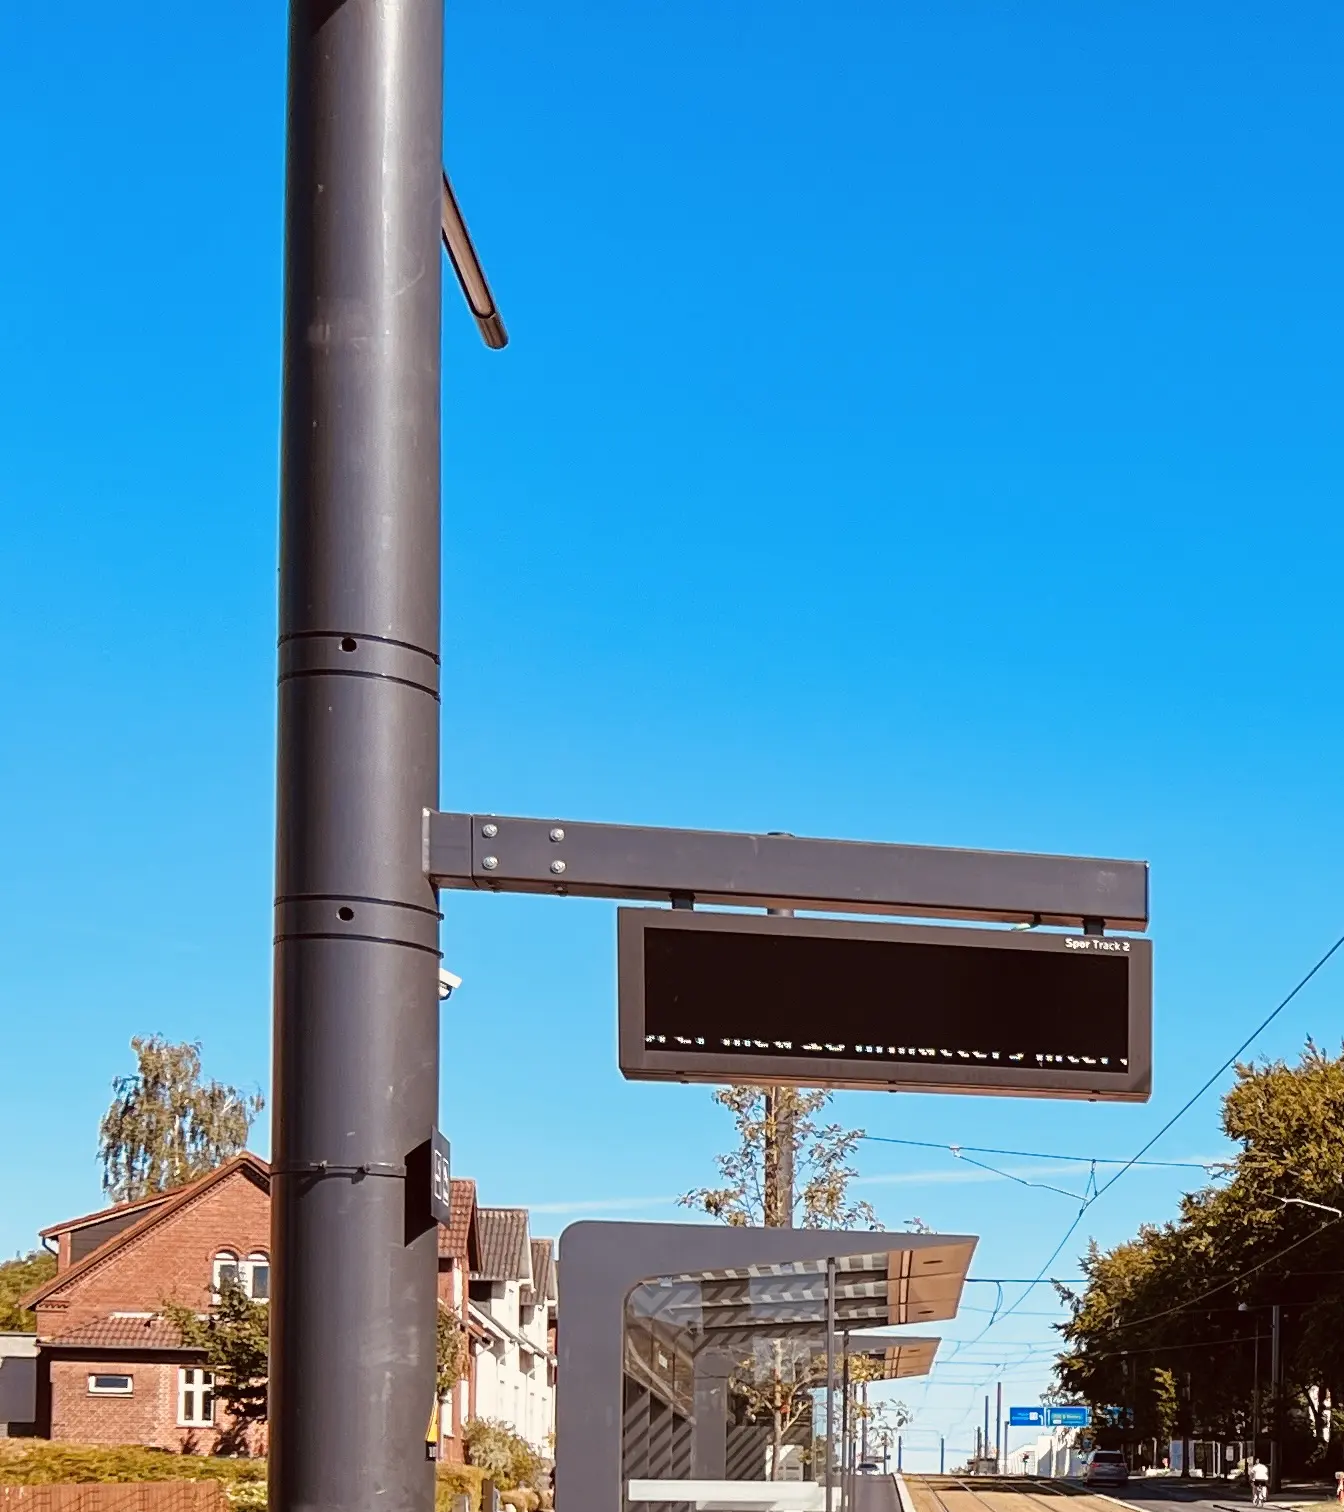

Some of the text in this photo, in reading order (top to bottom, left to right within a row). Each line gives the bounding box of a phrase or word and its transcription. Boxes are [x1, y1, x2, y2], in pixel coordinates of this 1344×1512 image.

[1065, 937, 1130, 952] Spor Track 2
